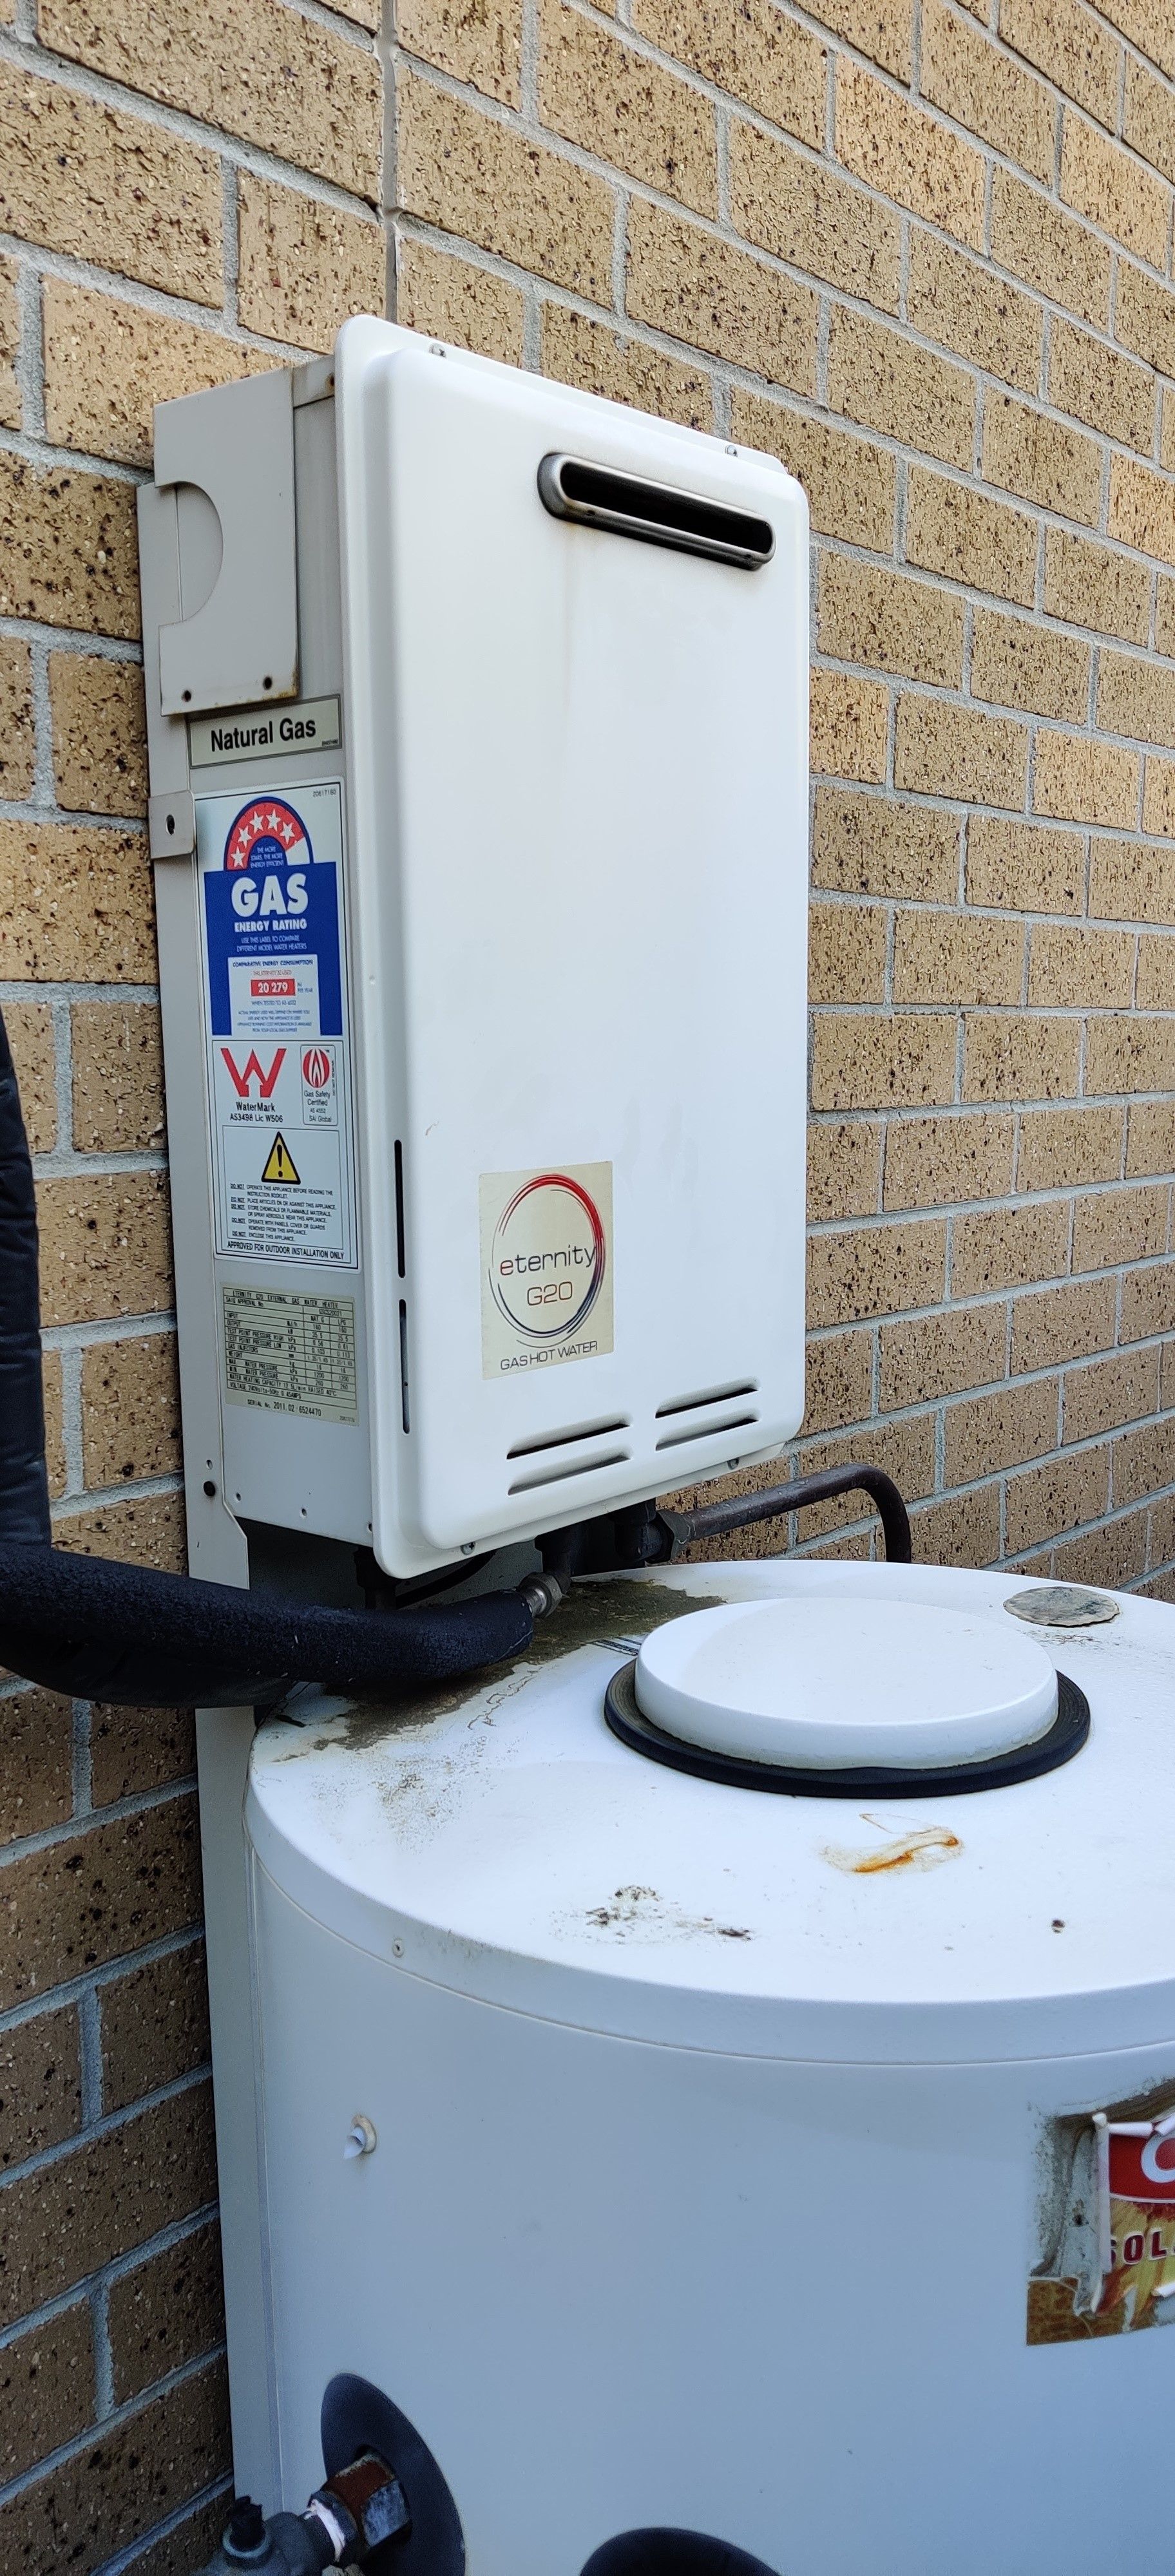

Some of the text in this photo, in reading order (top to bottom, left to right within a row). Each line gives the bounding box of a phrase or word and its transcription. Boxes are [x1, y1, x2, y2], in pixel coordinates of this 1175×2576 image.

[211, 718, 316, 752] Natural Gas
[231, 873, 309, 917] GAS
[234, 918, 307, 933] ENERGY RATING
[258, 981, 288, 994] 20 279
[316, 1090, 330, 1099] Safety
[236, 1101, 276, 1112] WaterMark
[227, 1241, 253, 1250] APPROVED
[265, 1245, 290, 1254] OUTDOOR
[292, 1247, 329, 1258] INSTALLATION
[330, 1251, 345, 1260] ONLY
[500, 1245, 597, 1276] eternity
[267, 1294, 287, 1304] EXTERNAL
[527, 1281, 573, 1306] G20
[253, 1331, 271, 1340] PRESSURE
[253, 1339, 271, 1347] PRESSURE
[501, 1340, 598, 1370] GAS HOT WATER
[258, 1363, 278, 1372] PRESSURE
[259, 1371, 278, 1379] PRESSURE
[243, 1376, 260, 1384] HEATING
[262, 1379, 282, 1387] CAPACITY
